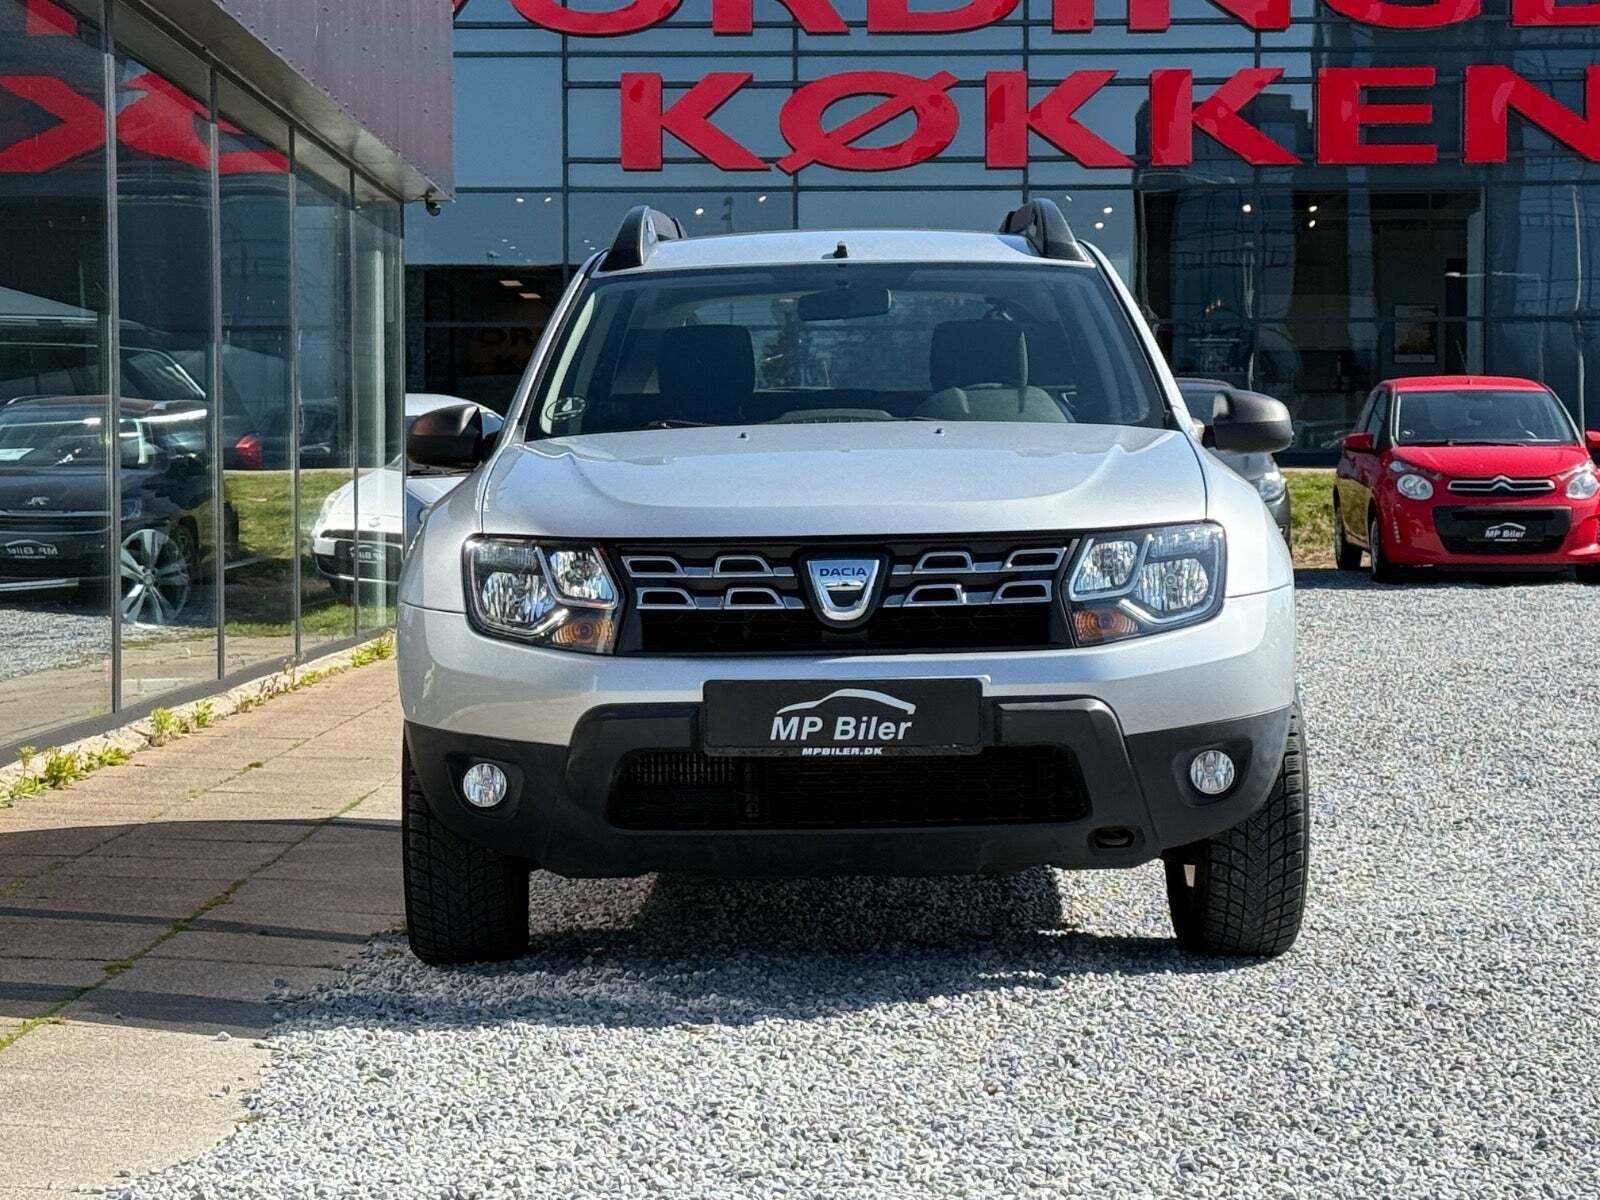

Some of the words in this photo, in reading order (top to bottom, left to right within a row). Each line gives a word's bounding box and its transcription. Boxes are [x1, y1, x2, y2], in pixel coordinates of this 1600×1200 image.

[620, 65, 1600, 174] KØKKEN
[1485, 530, 1501, 538] MP
[819, 567, 868, 577] DACIA
[770, 716, 824, 741] MP
[833, 716, 913, 741] Biler
[801, 747, 883, 756] MPBILER.DK
